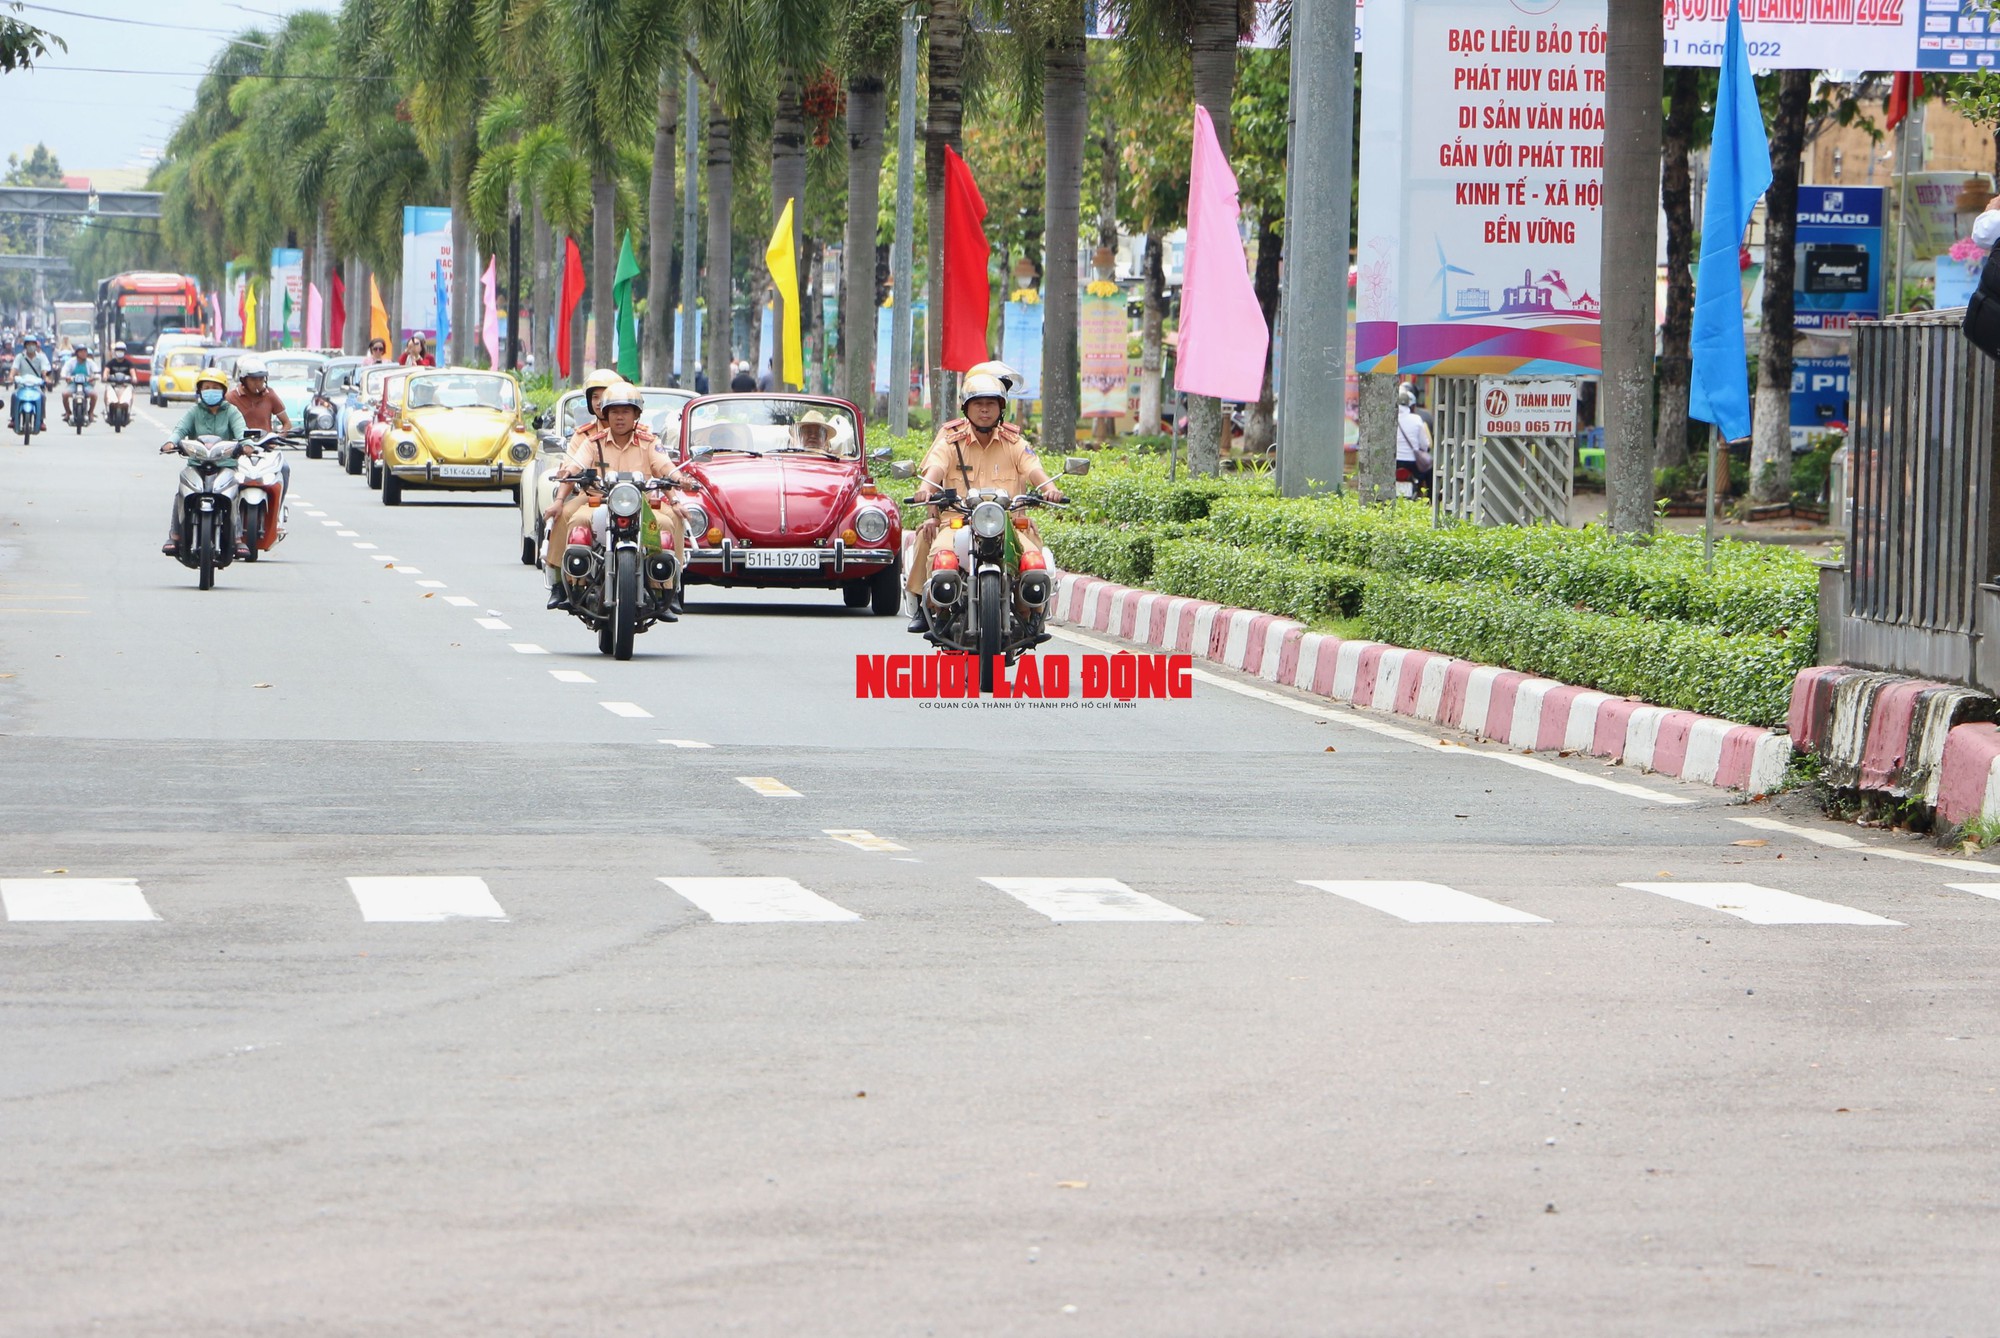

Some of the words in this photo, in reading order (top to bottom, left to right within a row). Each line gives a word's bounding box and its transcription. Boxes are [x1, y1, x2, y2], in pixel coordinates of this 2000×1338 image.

[1449, 29, 1485, 57] BẠC
[1491, 25, 1530, 53] LIÊU
[1536, 23, 1573, 54] BẢO
[1747, 42, 1781, 57] 022
[1454, 63, 1501, 91] PHÁT
[1507, 68, 1542, 92] HUY
[1548, 64, 1578, 92] GIÁ
[1459, 106, 1477, 129] DI
[1483, 98, 1520, 129] SẢN
[1526, 102, 1563, 130] VĂN
[1569, 103, 1605, 130] HÓA
[1439, 136, 1477, 167] GẮN
[1483, 140, 1512, 168] VỚI
[1518, 141, 1565, 168] PHÁT
[1456, 182, 1499, 205] KINH
[1506, 176, 1528, 206] TẾ
[1545, 179, 1569, 206] XÃ
[1484, 214, 1521, 244] BỀN
[1527, 217, 1575, 244] VỮNG
[1796, 212, 1869, 224] PINACO
[1812, 374, 1850, 392] PI
[1515, 391, 1548, 407] THÀNH
[1551, 393, 1571, 407] HUY
[1487, 420, 1521, 433] 0909
[1525, 420, 1550, 433] 065
[1554, 420, 1572, 433] 771
[748, 552, 817, 567] 51H-197.08
